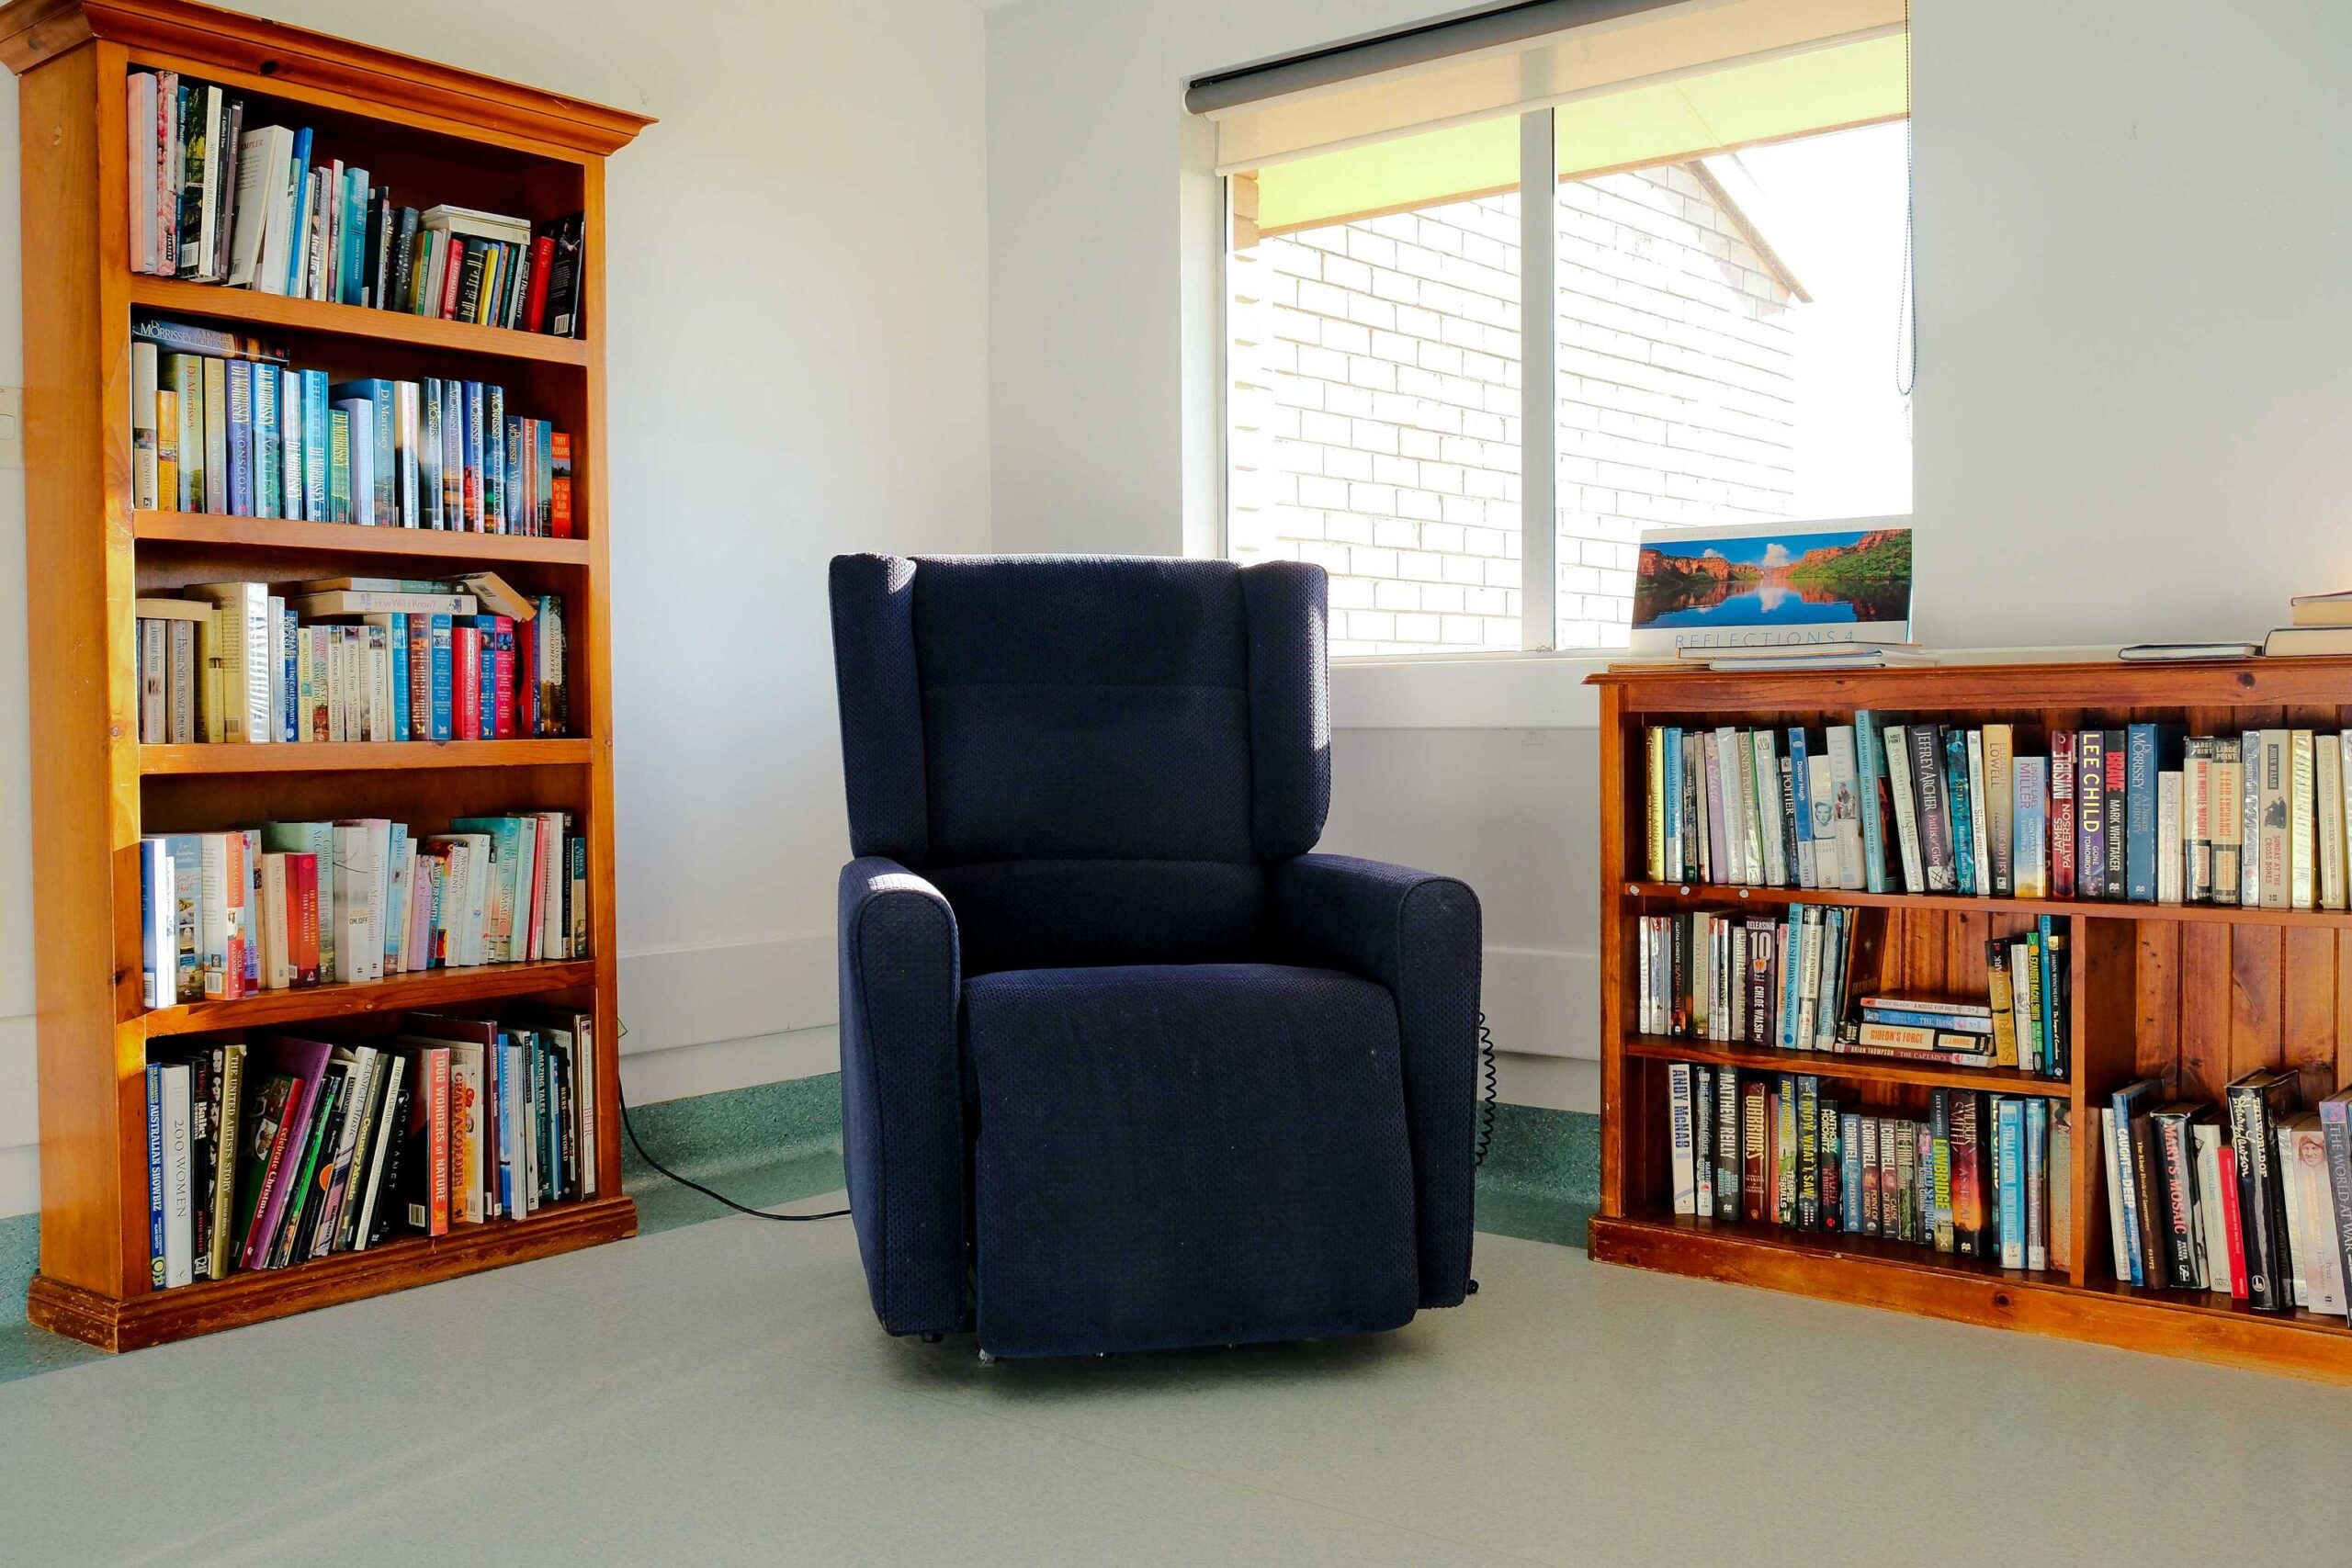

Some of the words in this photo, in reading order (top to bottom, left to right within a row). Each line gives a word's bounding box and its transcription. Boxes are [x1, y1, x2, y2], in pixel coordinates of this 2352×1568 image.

[447, 261, 459, 310] AFFIRMATIONS
[516, 280, 528, 320] Dictionary
[187, 365, 197, 379] Di
[232, 366, 248, 376] DI
[258, 369, 275, 381] DI
[187, 381, 197, 431] Morrissey
[232, 376, 249, 425] MORRISSEY
[258, 380, 275, 427] MORRISSEY
[380, 389, 390, 401] Di
[334, 413, 348, 423] DI
[379, 404, 390, 450] Morrissey
[470, 397, 481, 446] MORRISSEY
[492, 392, 501, 442] MORRISSEY
[237, 429, 246, 494] MONSOON
[309, 446, 324, 457] DI
[334, 423, 349, 468] MORRISSEY
[509, 423, 517, 467] MORRISSEY
[287, 448, 301, 501] MORRISSEY
[309, 456, 324, 504] MORRISSEY
[375, 597, 390, 606] How
[466, 677, 474, 716] WALTERS
[1739, 734, 1750, 773] SIDNEY
[1914, 731, 1932, 770] JEFFREY
[1989, 742, 2000, 789] LOWELL
[2083, 733, 2100, 769] LEE
[2132, 732, 2147, 789] MORRISSEY
[2268, 745, 2278, 763] JOHN
[1796, 761, 1805, 782] Doctor
[2019, 762, 2030, 809] MILLER
[2030, 762, 2039, 786] LINDA
[2052, 750, 2072, 799] INVISIBLE
[2106, 750, 2124, 793] BRAVE
[2268, 764, 2278, 789] WALSH
[1782, 774, 1793, 816] POITIER
[1797, 783, 1806, 801] Hugh
[1920, 771, 1937, 812] ARCHER
[2030, 787, 2039, 808] LAEL
[2083, 773, 2100, 832] CHILD
[1928, 814, 1939, 837] Paths
[2109, 798, 2120, 824] MARK
[2132, 793, 2142, 834] JOURNEY
[2141, 807, 2151, 832] Distant
[394, 829, 405, 861] Sophie
[2053, 818, 2063, 854] JAMES
[2062, 803, 2072, 868] PATTERSON
[2109, 825, 2120, 872] WHITTAKER
[322, 840, 331, 873] Colleen
[459, 855, 468, 890] MONICA
[2083, 835, 2092, 876] TOMORROW
[2091, 845, 2099, 865] GONE
[2265, 861, 2273, 884] BONES
[431, 897, 439, 920] SMITH
[1750, 931, 1771, 961] 10
[1790, 929, 1797, 939] NO
[1788, 940, 1796, 985] YESTERDAYS
[1993, 955, 2003, 977] PARK
[1754, 986, 1765, 1008] CHLOE
[1996, 980, 2007, 1002] TONY
[1754, 1009, 1764, 1033] WALSH
[2031, 1003, 2041, 1021] SMITH
[1867, 1047, 1894, 1056] THOMPSON
[1914, 1053, 1947, 1061] CAPTAIN'S
[1870, 1029, 1901, 1042] GIDEON'S
[1903, 1032, 1924, 1044] FORCE
[1999, 1020, 2014, 1062] SAFARI
[230, 1055, 239, 1076] THE
[356, 1057, 374, 1105] CLASSICAL
[435, 1055, 446, 1083] 1000
[228, 1078, 238, 1115] UNITED
[390, 1077, 401, 1096] FINAL
[454, 1072, 464, 1112] GRAB
[1673, 1069, 1689, 1101] ANDY
[1699, 1081, 1708, 1097] THE
[1720, 1072, 1736, 1124] MATTHEW
[1782, 1080, 1791, 1101] ANDY
[435, 1086, 446, 1142] WONDERS
[583, 1107, 593, 1138] BEER
[1674, 1106, 1690, 1148] McNAB
[1699, 1098, 1710, 1132] DUNGEON
[1746, 1095, 1765, 1159] WARRIORS
[1803, 1100, 1815, 1131] KNOW
[1950, 1101, 1964, 1145] SMITH
[1963, 1102, 1976, 1145] WILBUR
[2232, 1095, 2250, 1138] Henry
[2253, 1097, 2261, 1122] THE
[150, 1104, 160, 1165] AUSTRALIAN
[174, 1120, 185, 1151] 200
[224, 1119, 234, 1158] ARTISTS
[271, 1127, 288, 1169] celebrate
[356, 1117, 371, 1164] Country
[1701, 1132, 1710, 1155] HOUSE
[1720, 1126, 1736, 1159] REILLY
[1803, 1134, 1815, 1162] WHAT
[1821, 1109, 1829, 1154] HOROWITZ
[1829, 1109, 1838, 1154] ANTHONY
[1844, 1122, 1858, 1165] CORNWELL
[1862, 1123, 1876, 1169] CORNWELL
[1881, 1127, 1895, 1172] CORNWELL
[1896, 1128, 1912, 1144] THE
[2117, 1128, 2132, 1166] CAUGHT
[2164, 1124, 2178, 1175] MARY'S
[2255, 1119, 2266, 1161] WORLD
[2329, 1124, 2341, 1150] THE
[1897, 1145, 1913, 1166] FIRM
[2233, 1129, 2254, 1178] Lawson
[2258, 1159, 2267, 1179] OF
[152, 1167, 162, 1212] SHOWBIZ
[175, 1156, 187, 1218] WOMEN
[222, 1161, 232, 1193] STORY
[347, 1165, 362, 1201] Music
[435, 1158, 446, 1202] NATURE
[1803, 1175, 1815, 1198] SAW
[1933, 1139, 1950, 1210] LOWBRIDGE
[2334, 1155, 2346, 1201] WORLD
[256, 1171, 277, 1219] Christmas
[1849, 1179, 1857, 1216] PREDATOR
[1883, 1191, 1891, 1202] OF
[1919, 1189, 1928, 1212] Ground
[2122, 1179, 2135, 1209] DEEP
[2169, 1178, 2188, 1235] MOSAIC
[2339, 1204, 2349, 1218] AT
